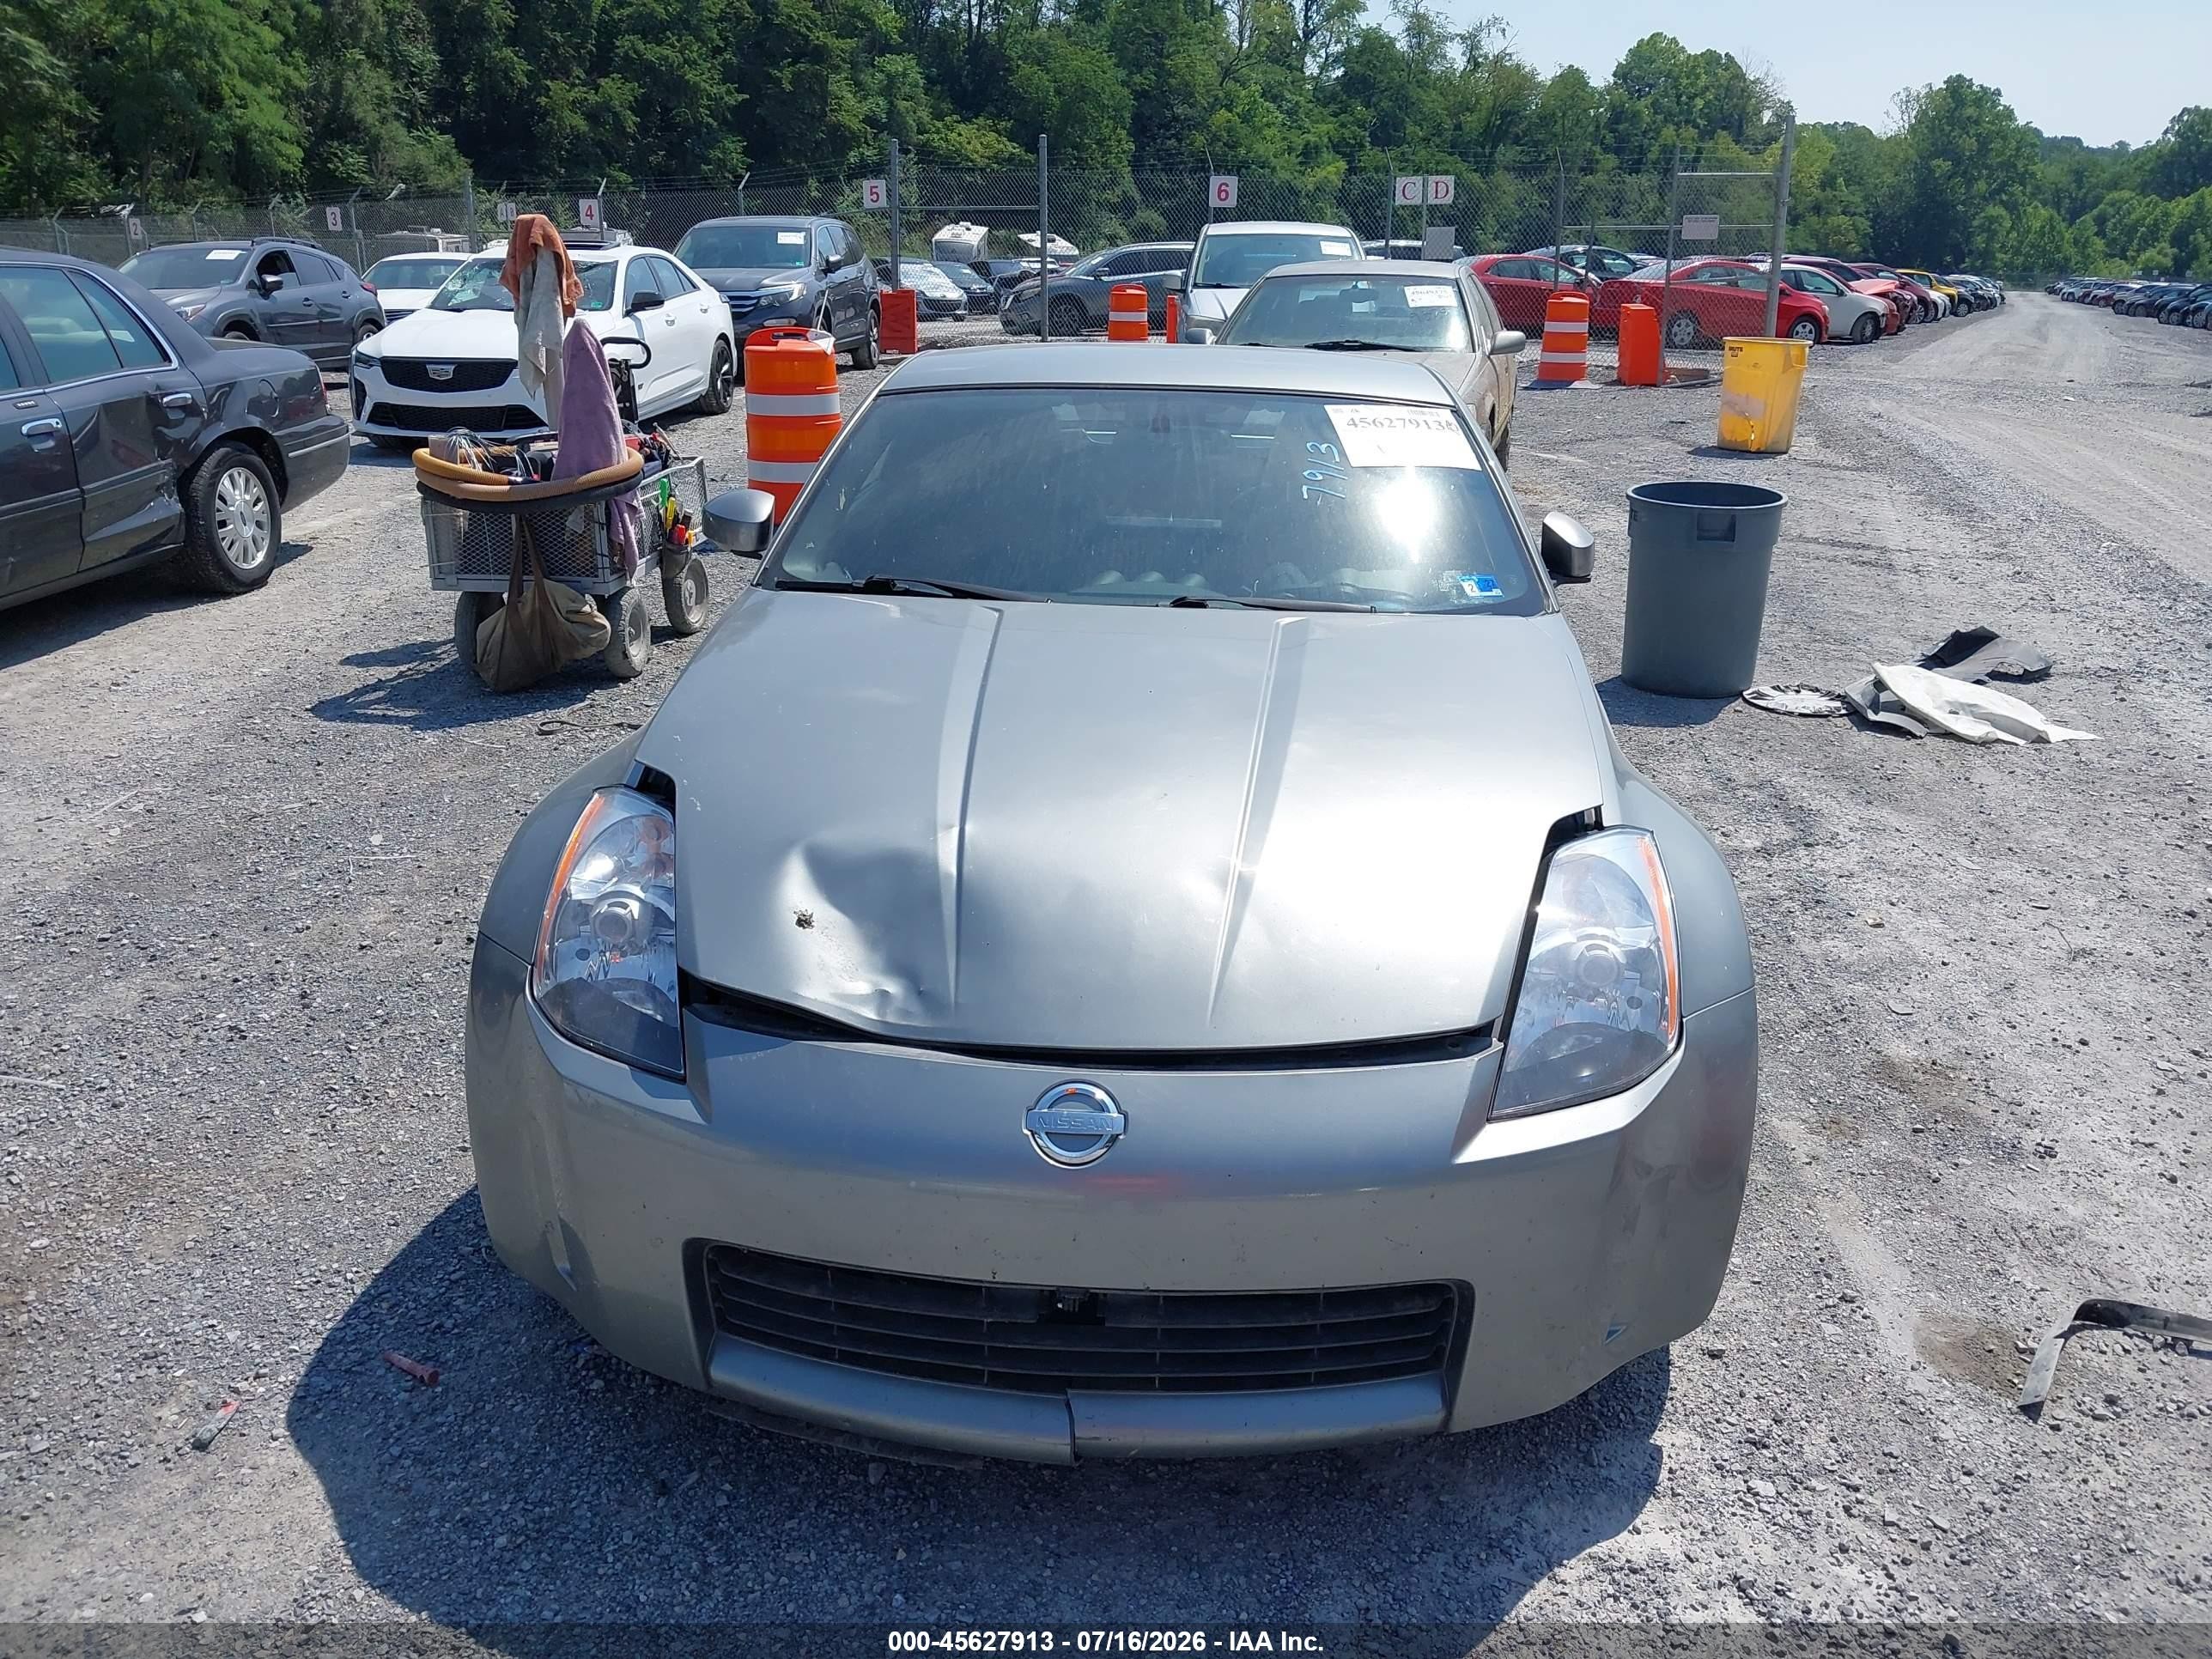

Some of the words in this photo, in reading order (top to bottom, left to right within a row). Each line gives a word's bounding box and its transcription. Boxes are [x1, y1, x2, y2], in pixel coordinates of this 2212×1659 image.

[869, 185, 880, 204] 5
[1217, 182, 1230, 202] 6
[1401, 181, 1416, 201] C
[1434, 180, 1449, 199] D
[331, 211, 337, 227] 3
[585, 204, 594, 221] 4
[132, 222, 139, 236] 2
[1302, 441, 1348, 499] 7913
[1036, 1116, 1113, 1131] NISSAN
